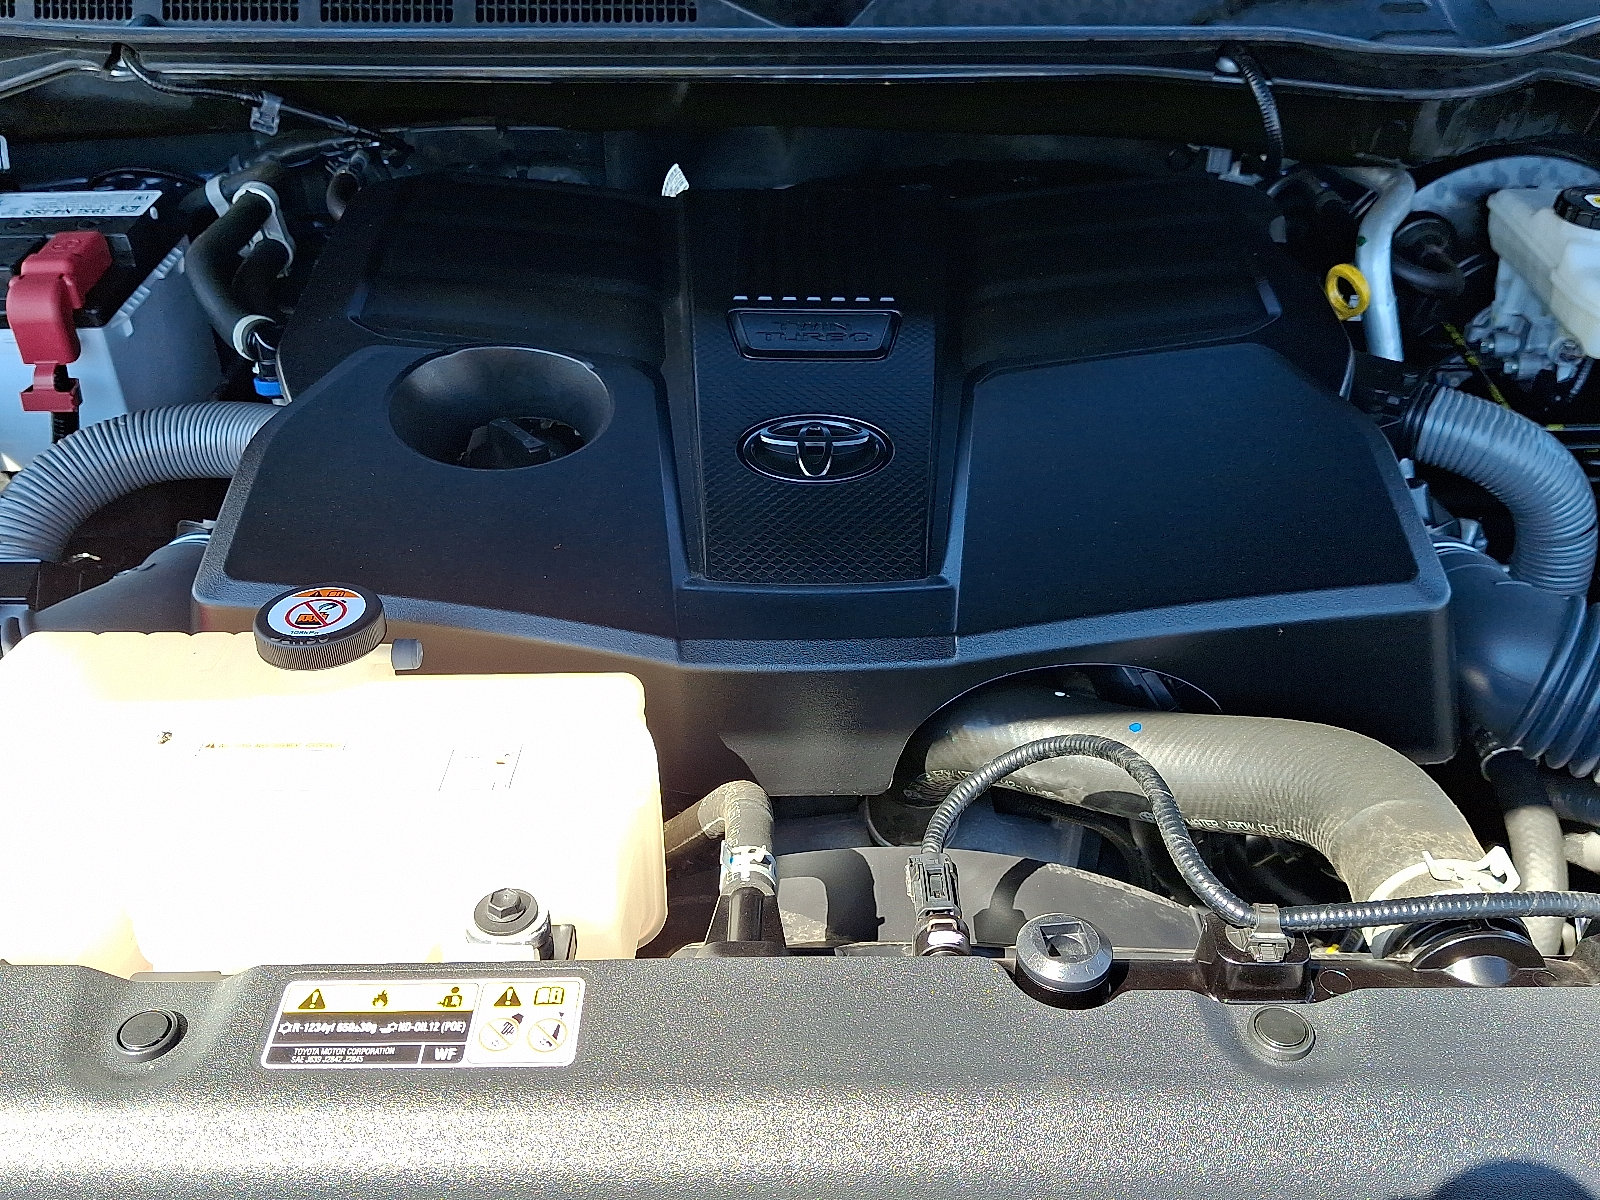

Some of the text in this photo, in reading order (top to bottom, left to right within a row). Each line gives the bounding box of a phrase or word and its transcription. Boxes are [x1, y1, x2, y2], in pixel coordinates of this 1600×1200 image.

[756, 331, 872, 342] TURBO
[440, 1020, 467, 1034] (POE)
[294, 1046, 396, 1056] TOYOTA MOTOR CORPORATION
[434, 1047, 458, 1061] WF
[291, 1055, 305, 1063] SAE
